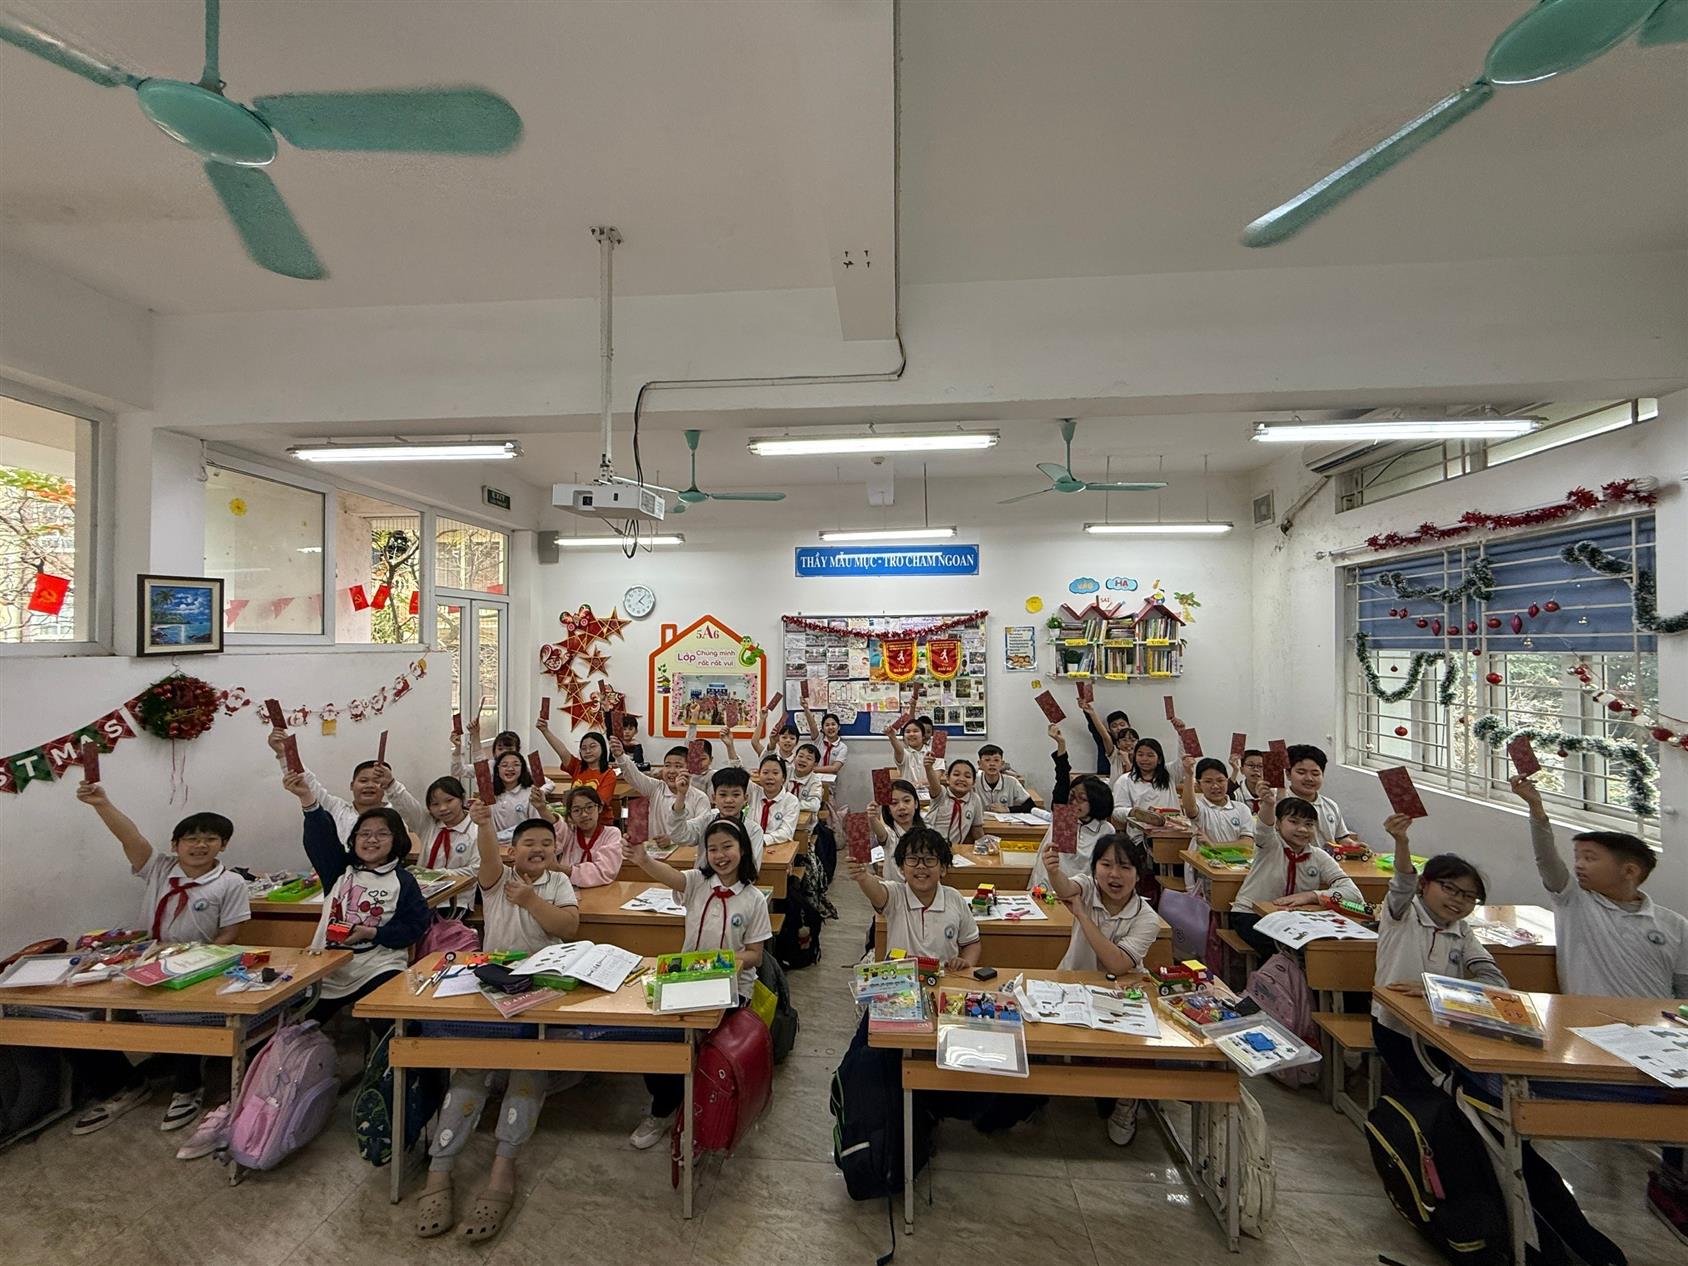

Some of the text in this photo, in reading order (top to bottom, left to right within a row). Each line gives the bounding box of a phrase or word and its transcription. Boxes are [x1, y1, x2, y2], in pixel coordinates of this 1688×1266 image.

[938, 554, 974, 567] NGOAN
[696, 625, 720, 639] 5A6
[678, 653, 696, 663] Lớp
